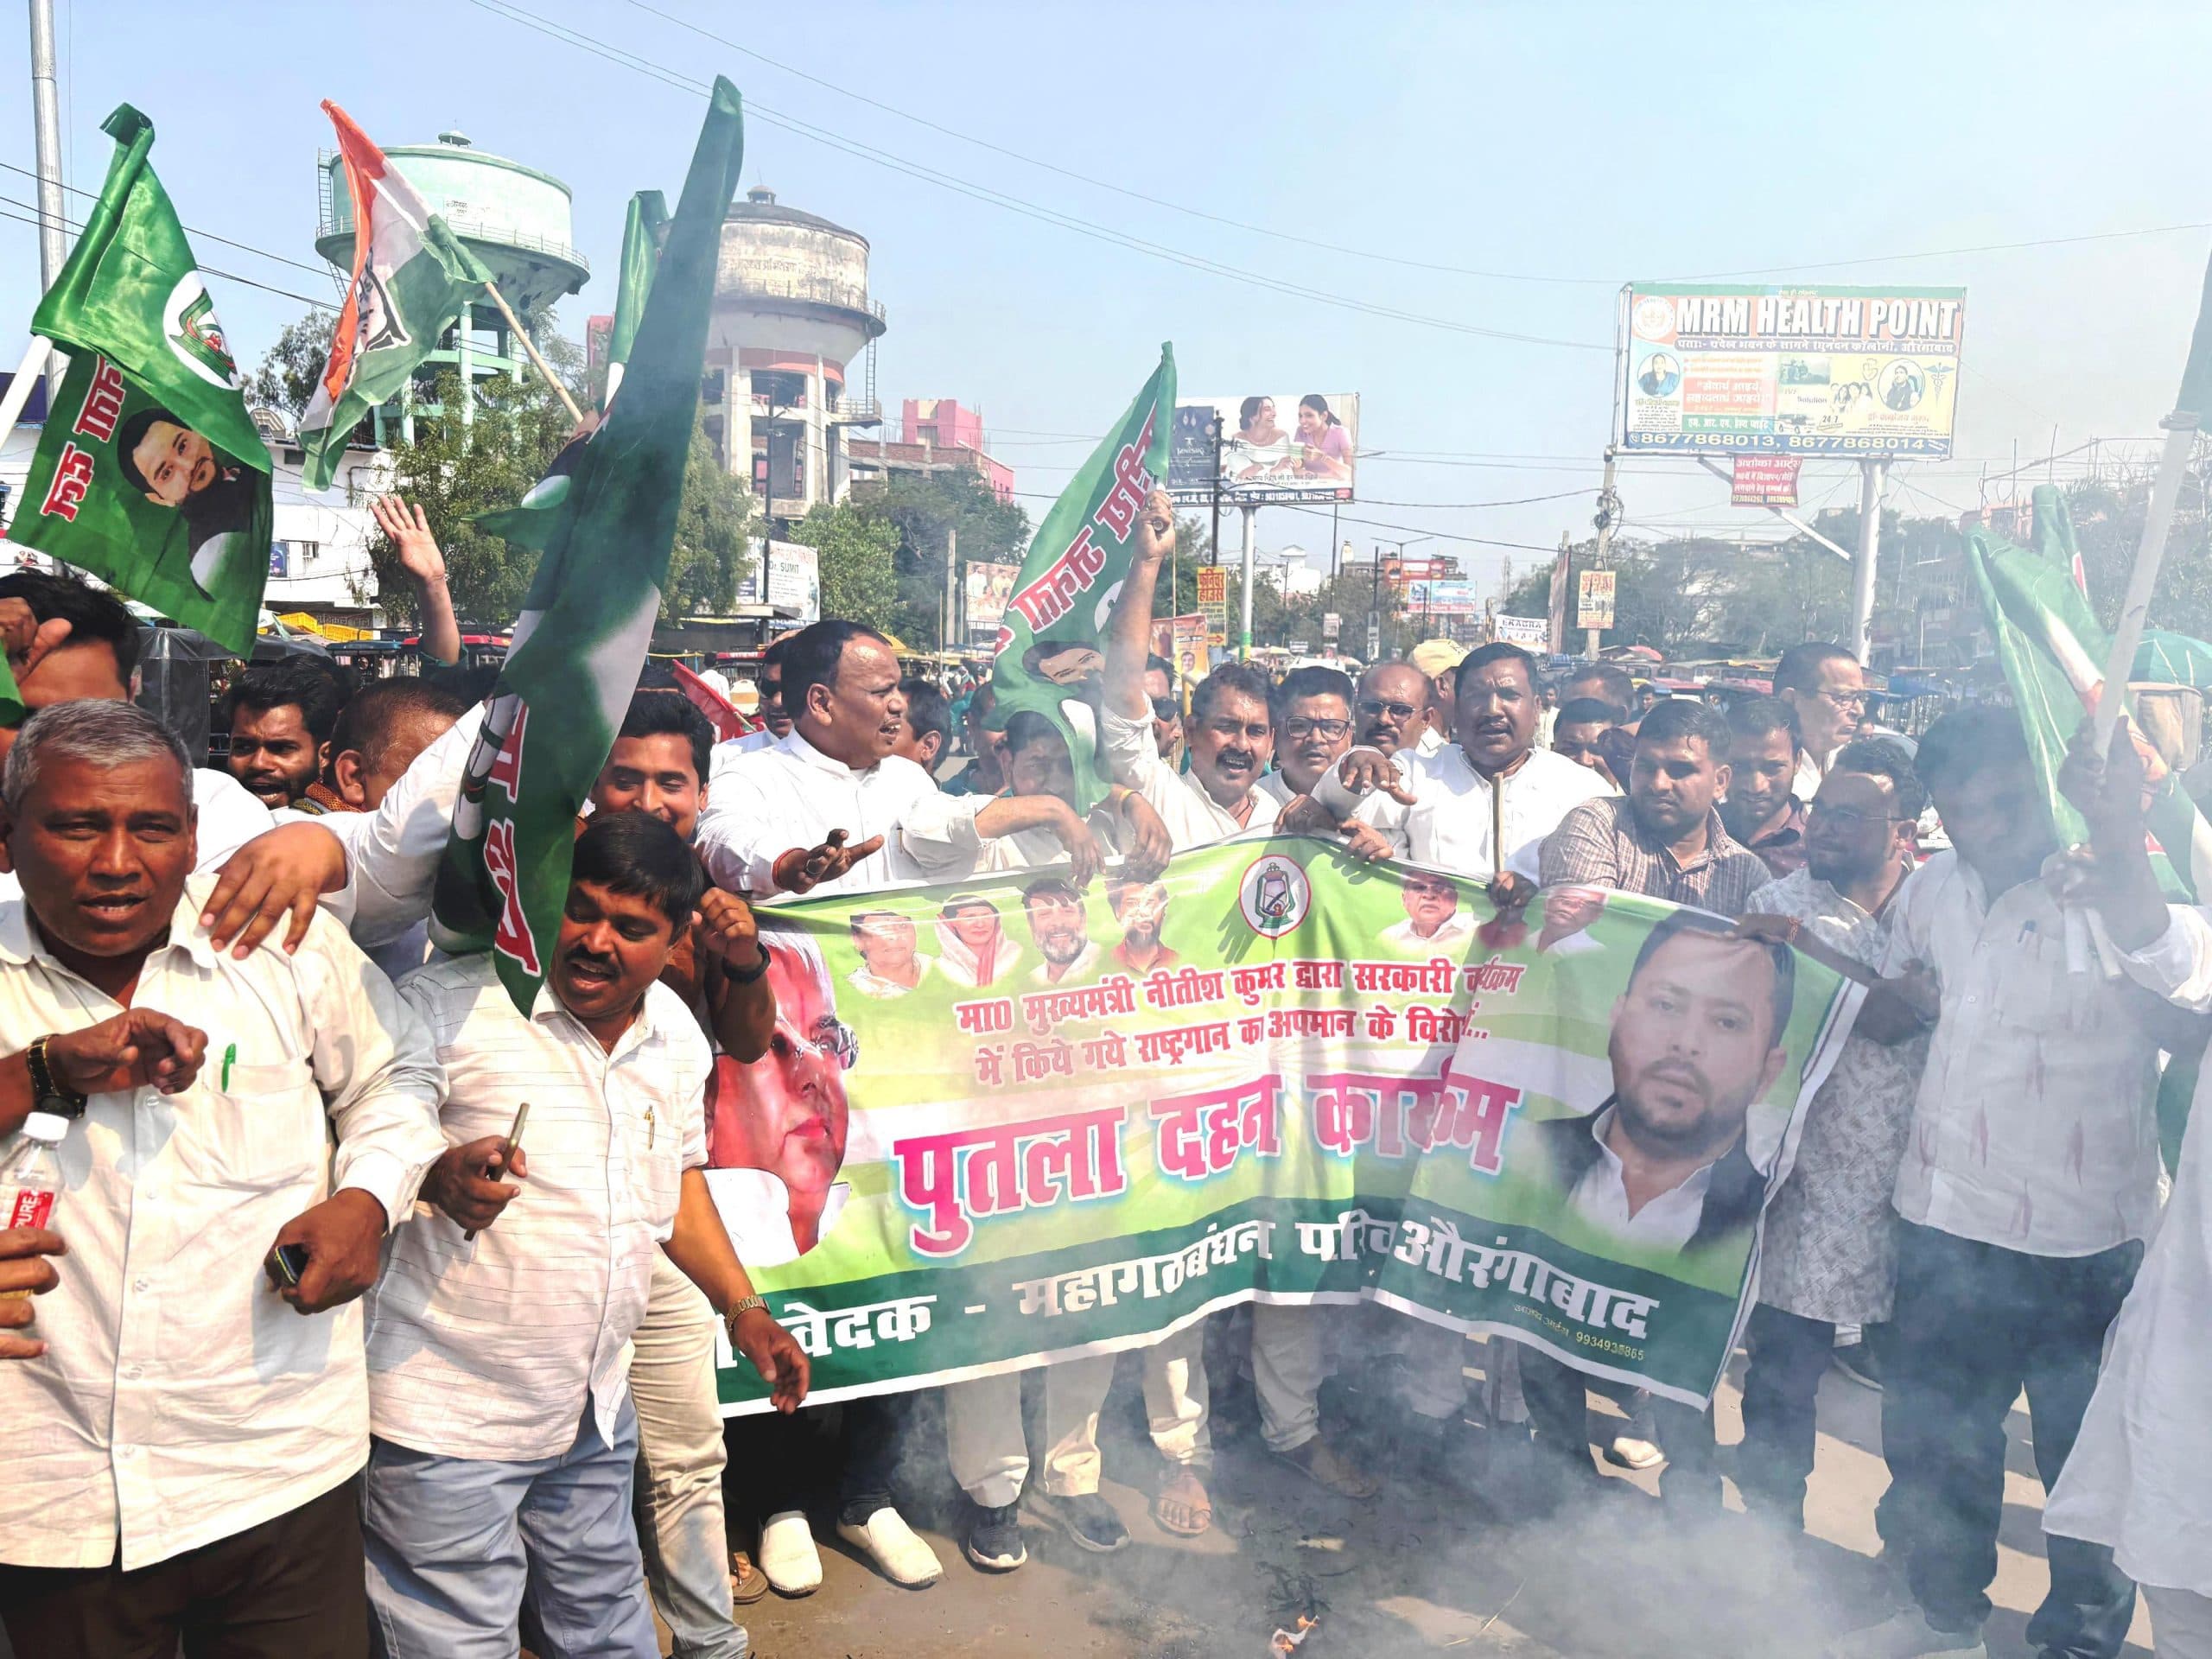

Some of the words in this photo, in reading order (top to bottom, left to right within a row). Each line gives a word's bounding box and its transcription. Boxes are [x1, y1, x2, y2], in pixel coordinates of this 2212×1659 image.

[1676, 297, 1751, 335] MRM
[1757, 298, 1863, 337] HEALTH
[1869, 299, 1961, 339] POINT
[1789, 435, 1925, 450] 8677868014
[780, 562, 799, 574] SUMIT
[1023, 976, 1135, 1034] मुख्यमंत्री
[1142, 969, 1224, 1008] नीतीश
[1293, 961, 1344, 988] द्वारा
[1352, 958, 1457, 994] सरकारी
[976, 1044, 1005, 1085] में
[1013, 1038, 1074, 1082] किये
[1082, 1030, 1128, 1070] गये
[1135, 1021, 1231, 1065] राष्ट्रगान
[1237, 1015, 1265, 1046] का
[1268, 1010, 1357, 1038] अपमान
[1365, 1005, 1397, 1040] के
[893, 1106, 1125, 1254] पुतला
[1150, 1073, 1282, 1178] दहन
[1012, 1219, 1276, 1319] महागठबंधन
[1393, 1215, 1661, 1340] औरंगाबाद
